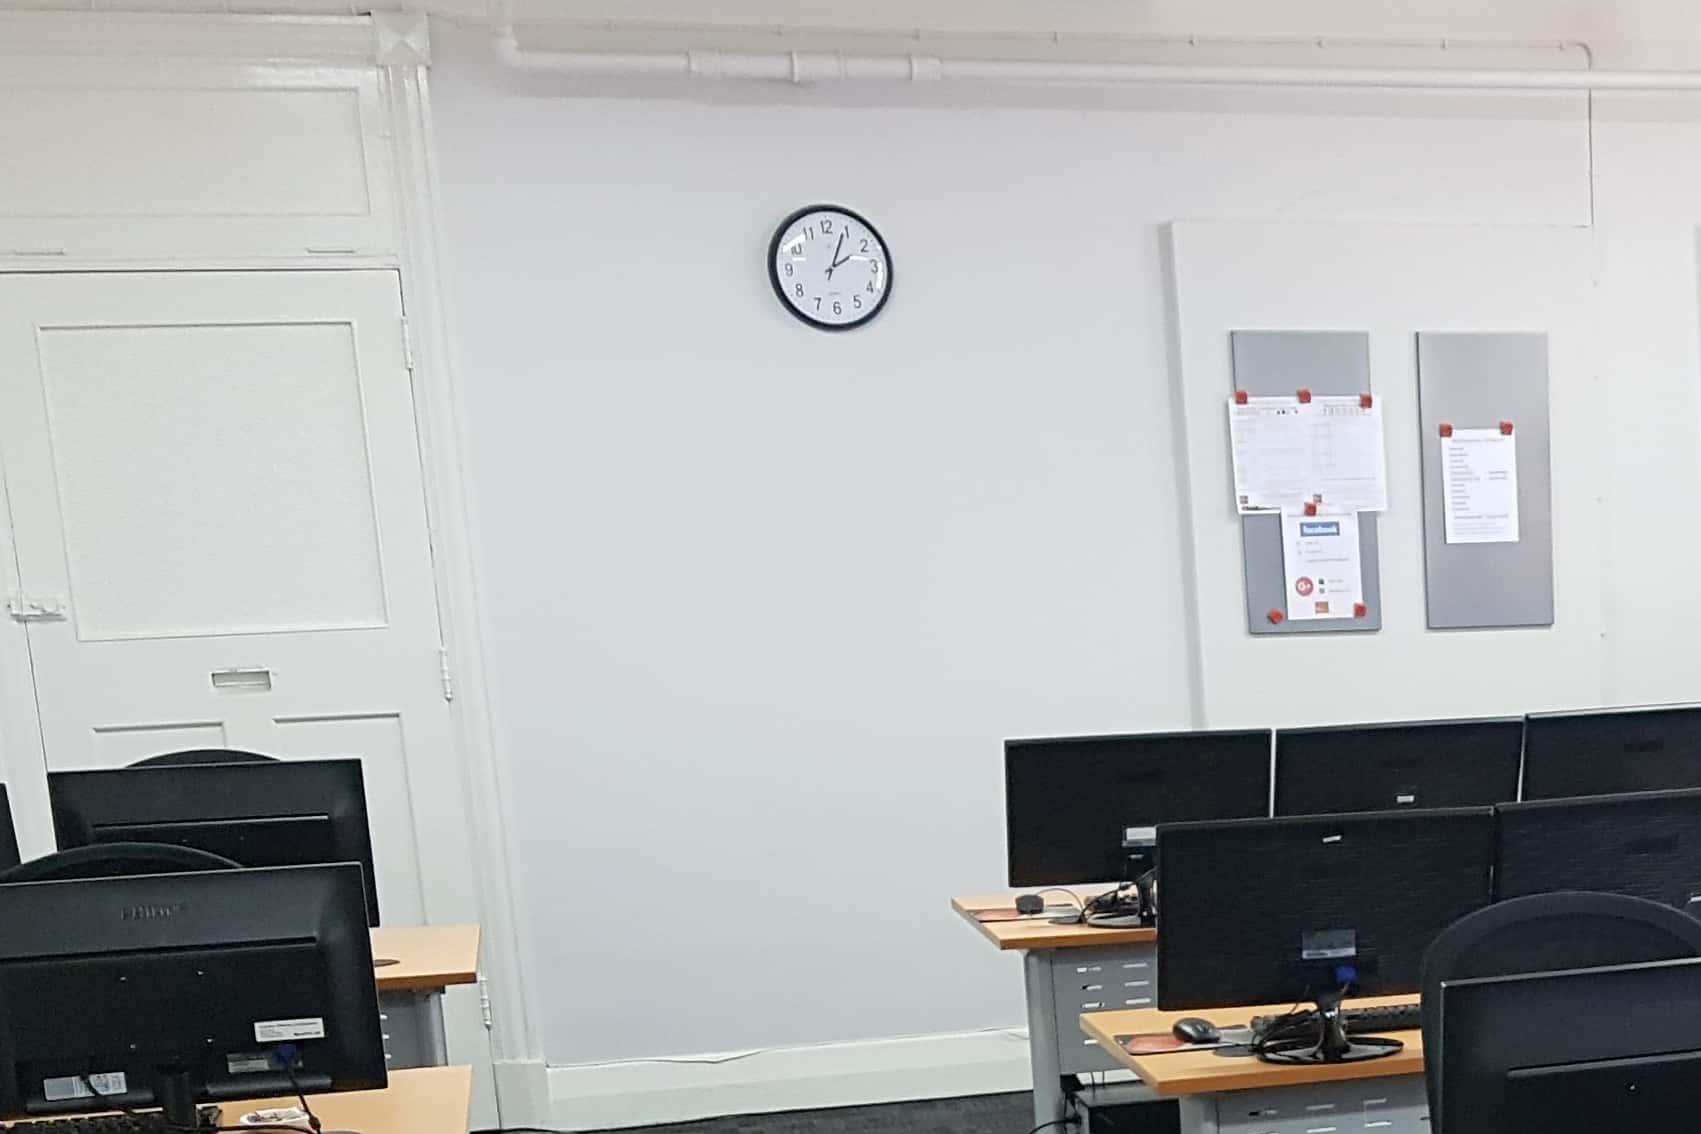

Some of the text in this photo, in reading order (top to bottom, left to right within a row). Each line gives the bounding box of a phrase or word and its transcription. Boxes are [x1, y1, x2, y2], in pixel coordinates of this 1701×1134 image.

[803, 227, 814, 240] 11
[820, 220, 832, 234] 12
[844, 225, 850, 239] 1
[860, 239, 869, 253] 2
[785, 263, 794, 277] 9
[870, 259, 878, 274] 3
[795, 283, 804, 297] 8
[866, 280, 874, 293] 4
[814, 297, 822, 311] 7
[833, 301, 842, 315] 6
[853, 295, 862, 309] 5
